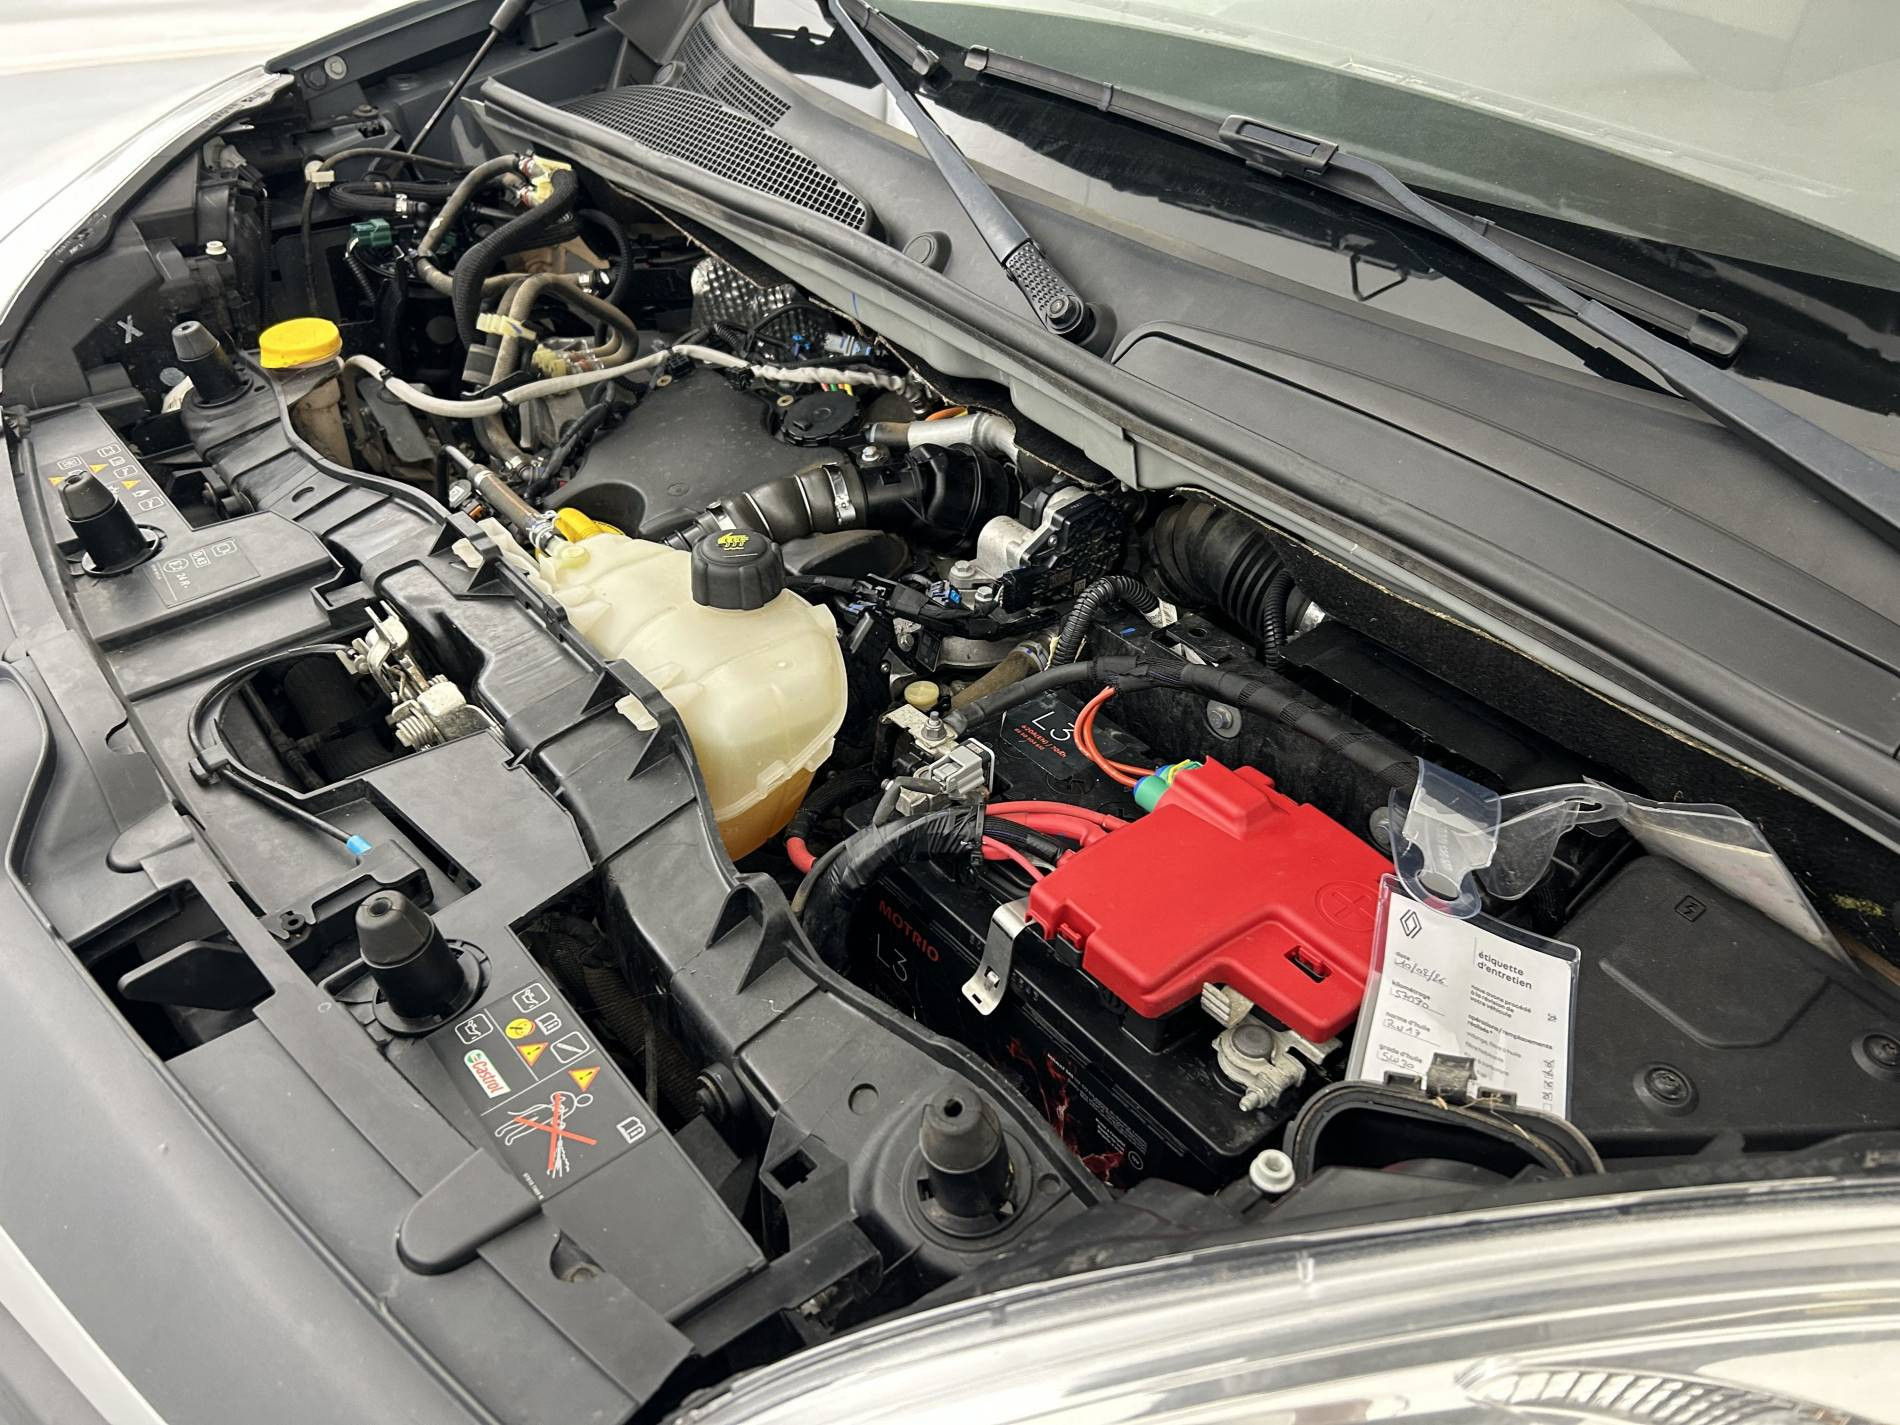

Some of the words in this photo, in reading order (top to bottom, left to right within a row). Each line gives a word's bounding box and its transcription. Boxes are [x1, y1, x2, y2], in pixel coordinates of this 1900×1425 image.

[1031, 711, 1075, 741] L3
[879, 900, 940, 962] MOTRIO
[877, 933, 908, 982] L3
[1478, 951, 1524, 976] étiquette
[472, 1060, 504, 1094] Castrol
